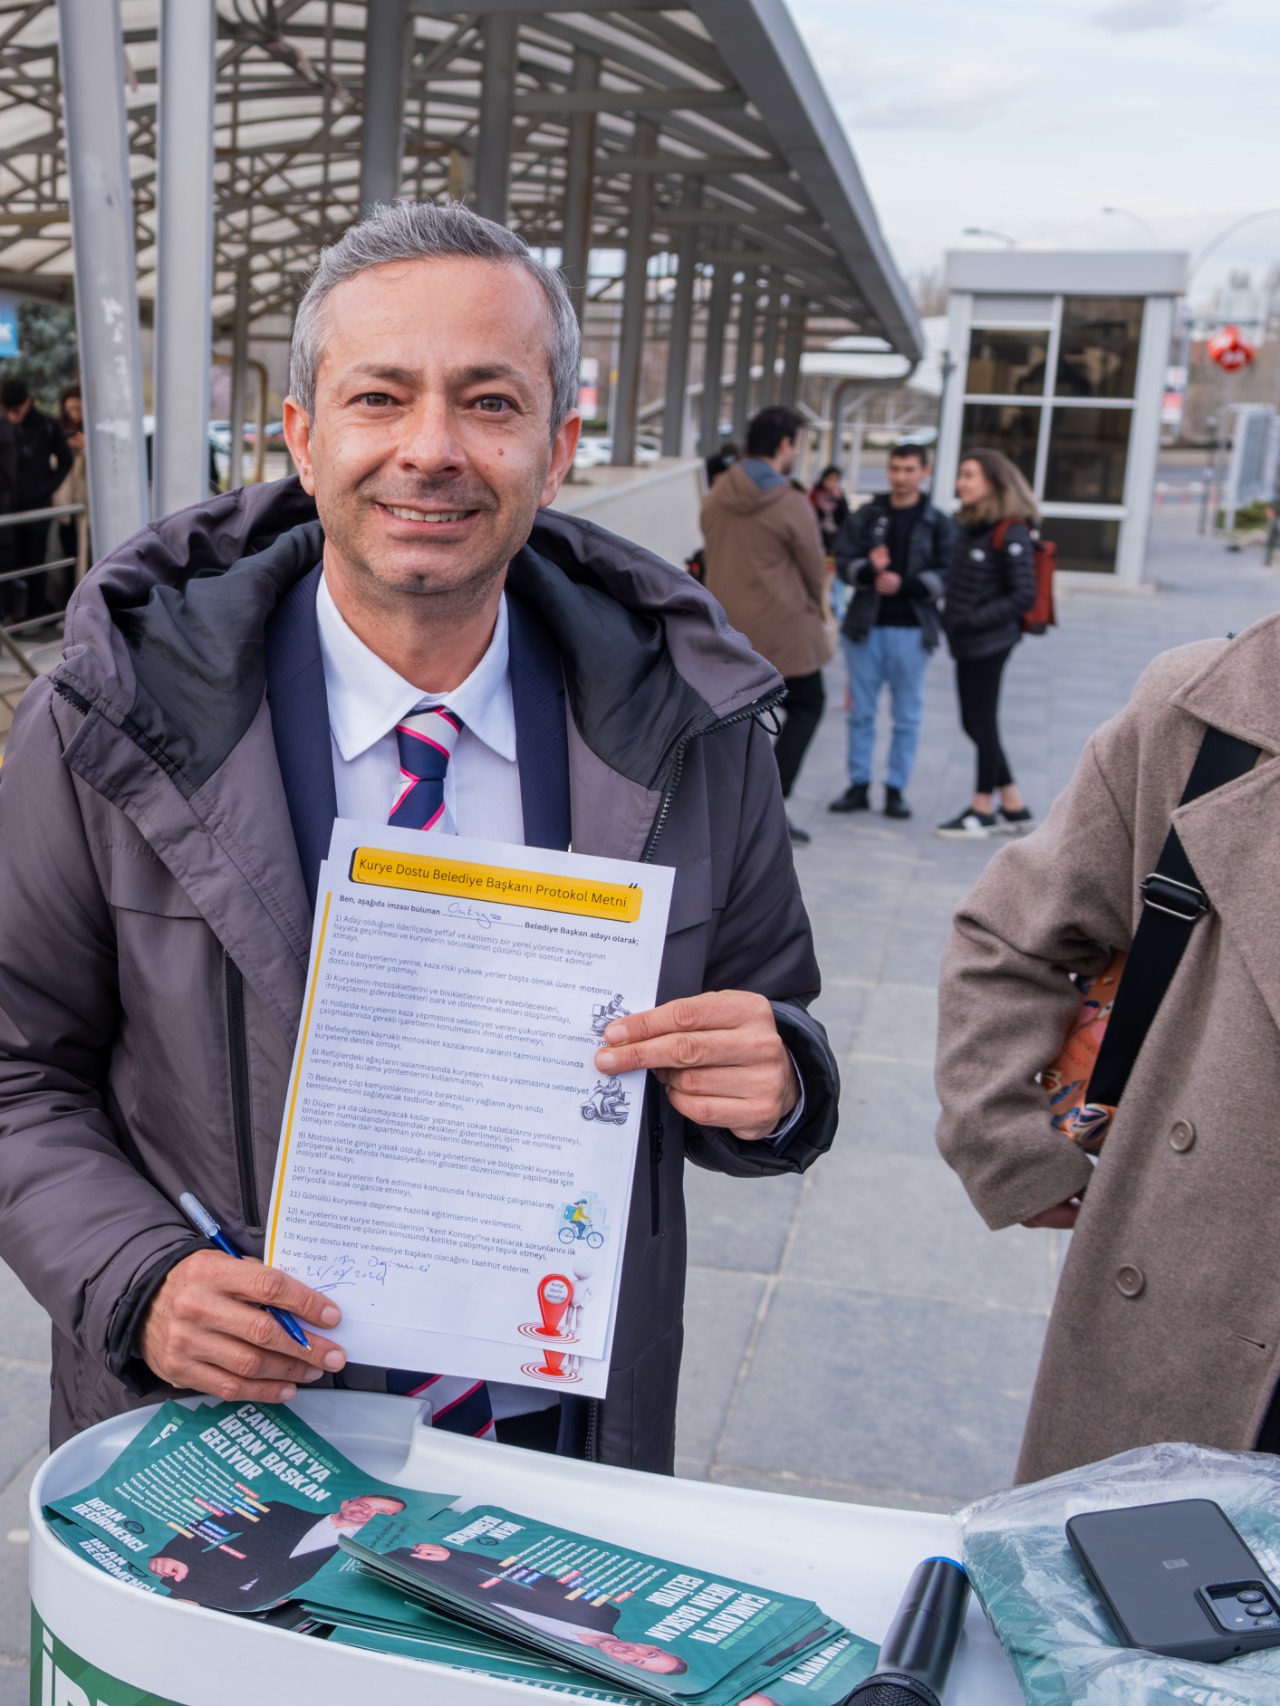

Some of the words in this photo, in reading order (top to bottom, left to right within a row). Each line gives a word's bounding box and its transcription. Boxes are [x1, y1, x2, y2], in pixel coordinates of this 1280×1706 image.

[359, 858, 393, 874] Kurye
[395, 863, 430, 878] Dostu
[432, 868, 483, 887] Belediye
[485, 876, 532, 893] Başkanı
[535, 883, 587, 901] Protokol
[590, 892, 626, 907] Metni
[339, 894, 355, 904] Ben,
[357, 898, 385, 907] aşağıda
[386, 901, 409, 910] imzası
[410, 904, 440, 915] bulunan
[333, 922, 359, 932] hayata
[408, 933, 445, 944] kuryelerin
[446, 939, 490, 951] sorunlarının
[491, 945, 522, 956] çözümü
[522, 949, 537, 958] için
[538, 953, 563, 962] somut
[563, 957, 593, 966] adımlar
[342, 915, 362, 925] Aday
[362, 918, 394, 928] olduğum
[434, 929, 456, 937] şeffaf
[466, 932, 498, 944] katılımcı
[499, 937, 511, 945] bir
[511, 941, 531, 949] yerel
[532, 943, 564, 953] yönetim
[524, 921, 558, 933] Belediye
[559, 926, 588, 937] Başkan
[589, 932, 611, 941] adayı
[611, 935, 638, 946] olarak;
[327, 956, 349, 965] dostu
[349, 959, 386, 970] bariyerler
[337, 949, 354, 957] Katil
[355, 951, 397, 963] bariyerlerin
[397, 958, 422, 968] yerine,
[423, 960, 440, 969] kaza
[440, 963, 456, 971] riski
[457, 966, 483, 975] yüksek
[483, 971, 507, 979] yerler
[507, 973, 529, 983] başta
[530, 977, 553, 986] olmak
[554, 980, 576, 990] üzere
[579, 985, 612, 995] motorcu
[333, 974, 371, 985] Kuryelerin
[371, 980, 428, 993] motosikletlerini
[439, 988, 485, 1001] bisikletlerini
[485, 996, 503, 1004] park
[368, 988, 428, 1001] giderebilecekleri
[457, 1000, 493, 1011] dinlenme
[493, 1006, 522, 1016] alanları
[289, 1189, 300, 1198] 11)
[301, 1191, 331, 1201] Gönüllü
[332, 1195, 367, 1207] kuryelere
[368, 1201, 402, 1212] depreme
[403, 1205, 430, 1216] hazırlık
[431, 1210, 478, 1223] eğitimlerinin
[285, 1215, 306, 1223] elden
[308, 1217, 351, 1230] anlatmasını
[362, 1226, 387, 1235] çözüm
[388, 1229, 430, 1242] konusunda
[430, 1235, 457, 1245] birlikte
[458, 1240, 494, 1252] çalışmayı
[495, 1245, 517, 1255] teşvik
[287, 1206, 298, 1215] 12)
[299, 1208, 337, 1220] Kuryelerin
[349, 1215, 370, 1225] kurye
[371, 1218, 424, 1232] temsilcilerinin
[491, 1236, 523, 1247] katılarak
[524, 1242, 566, 1253] sorunlarını
[283, 1231, 295, 1240] 13)
[295, 1233, 318, 1243] Kurye
[319, 1236, 341, 1245] dostu
[341, 1239, 358, 1248] kent
[370, 1243, 403, 1255] belediye
[404, 1248, 432, 1259] başkanı
[433, 1253, 469, 1264] olacağımı
[471, 1258, 500, 1269] taahhüt
[302, 1251, 328, 1261] Soyad:
[199, 1427, 264, 1481] GELİYOR
[217, 1414, 267, 1456] İRFAN
[260, 1452, 332, 1502] BAŞKAN
[236, 1403, 331, 1483] ÇANKAYA'YA
[71, 1504, 149, 1553] DEĞİRMENCİ
[84, 1497, 127, 1522] İRFAN
[645, 1573, 705, 1607] GELİYOR
[688, 1582, 738, 1611] İRFAN
[644, 1605, 708, 1642] BAŞKAN
[688, 1590, 770, 1645] ÇANKAYA'YA
